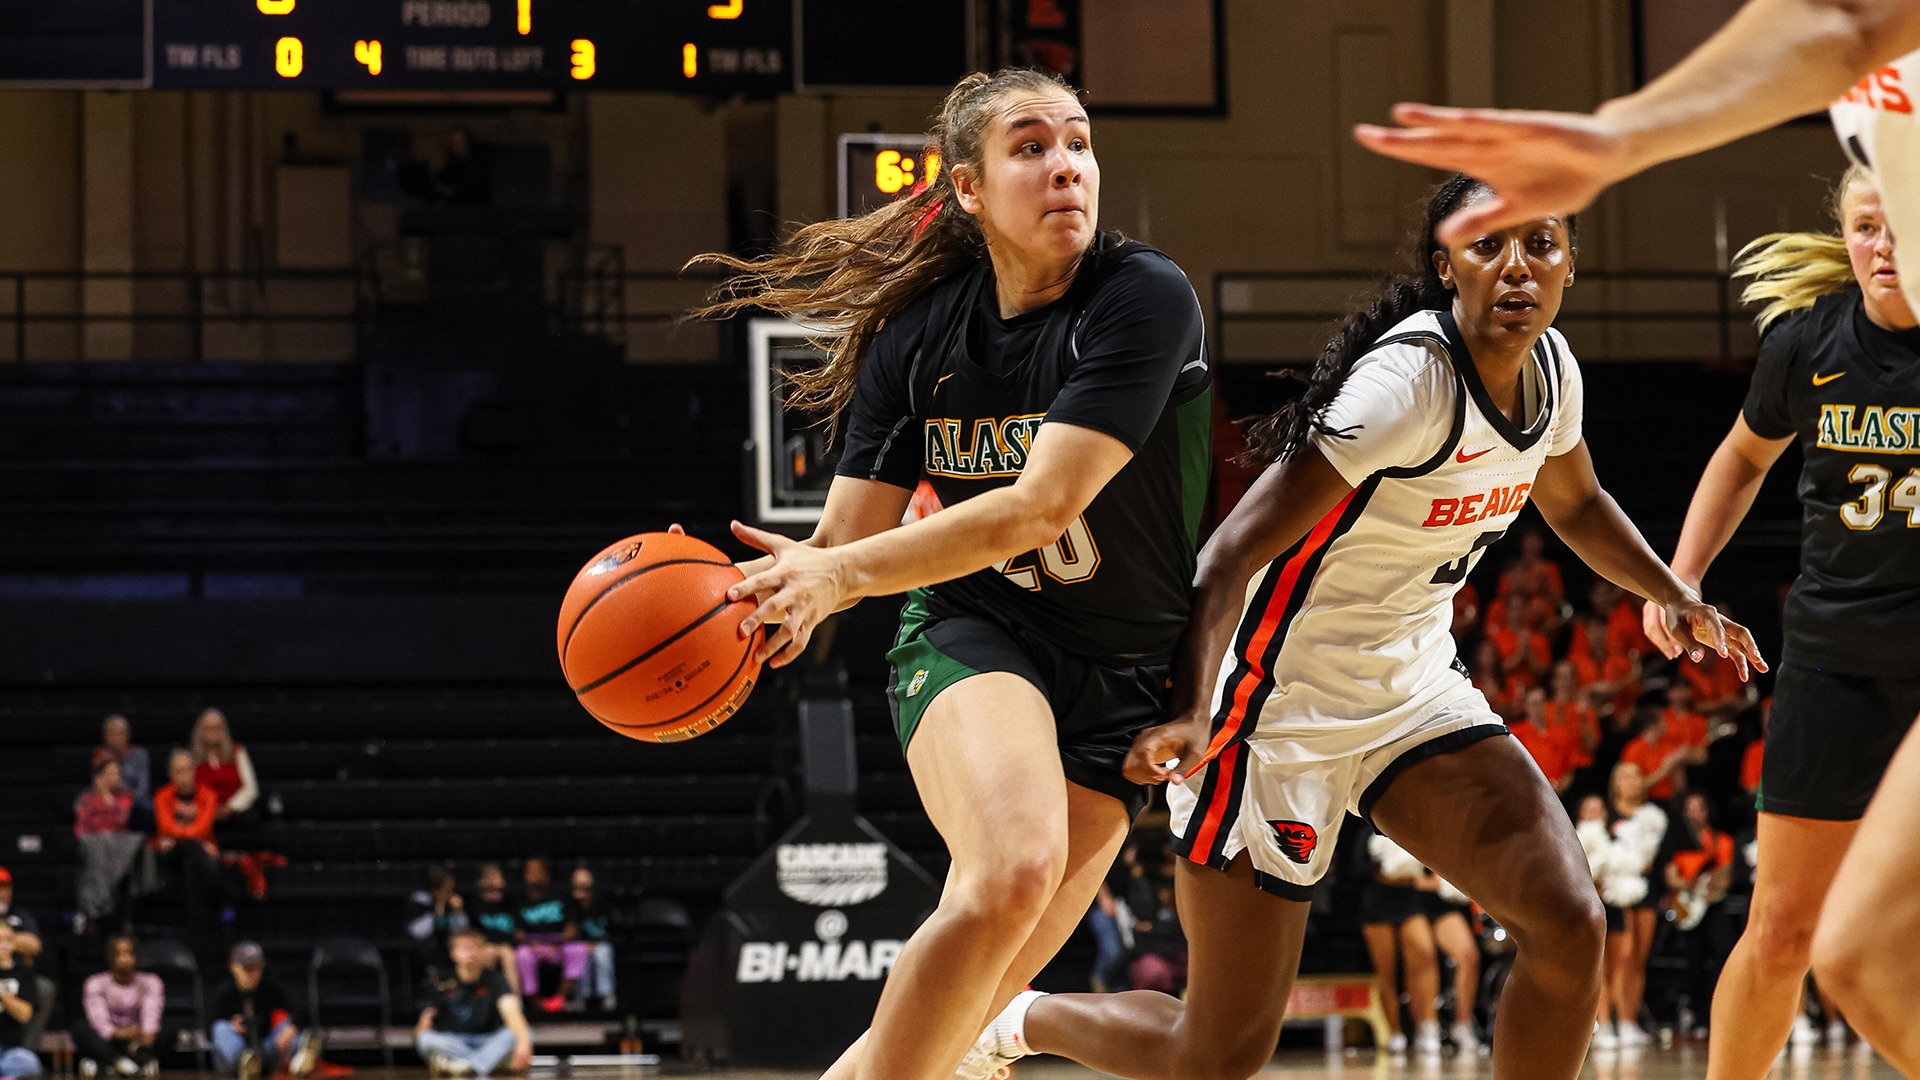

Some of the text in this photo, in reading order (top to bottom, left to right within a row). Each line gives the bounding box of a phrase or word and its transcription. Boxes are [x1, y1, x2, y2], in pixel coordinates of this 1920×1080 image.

[402, 0, 491, 27] PERIOD
[275, 36, 304, 78] 0
[353, 39, 383, 76] 4
[405, 46, 447, 71] TIME
[570, 38, 596, 80] 3
[682, 42, 697, 78] 1
[1839, 463, 1920, 531] 34
[736, 939, 907, 983] BI-MAR
